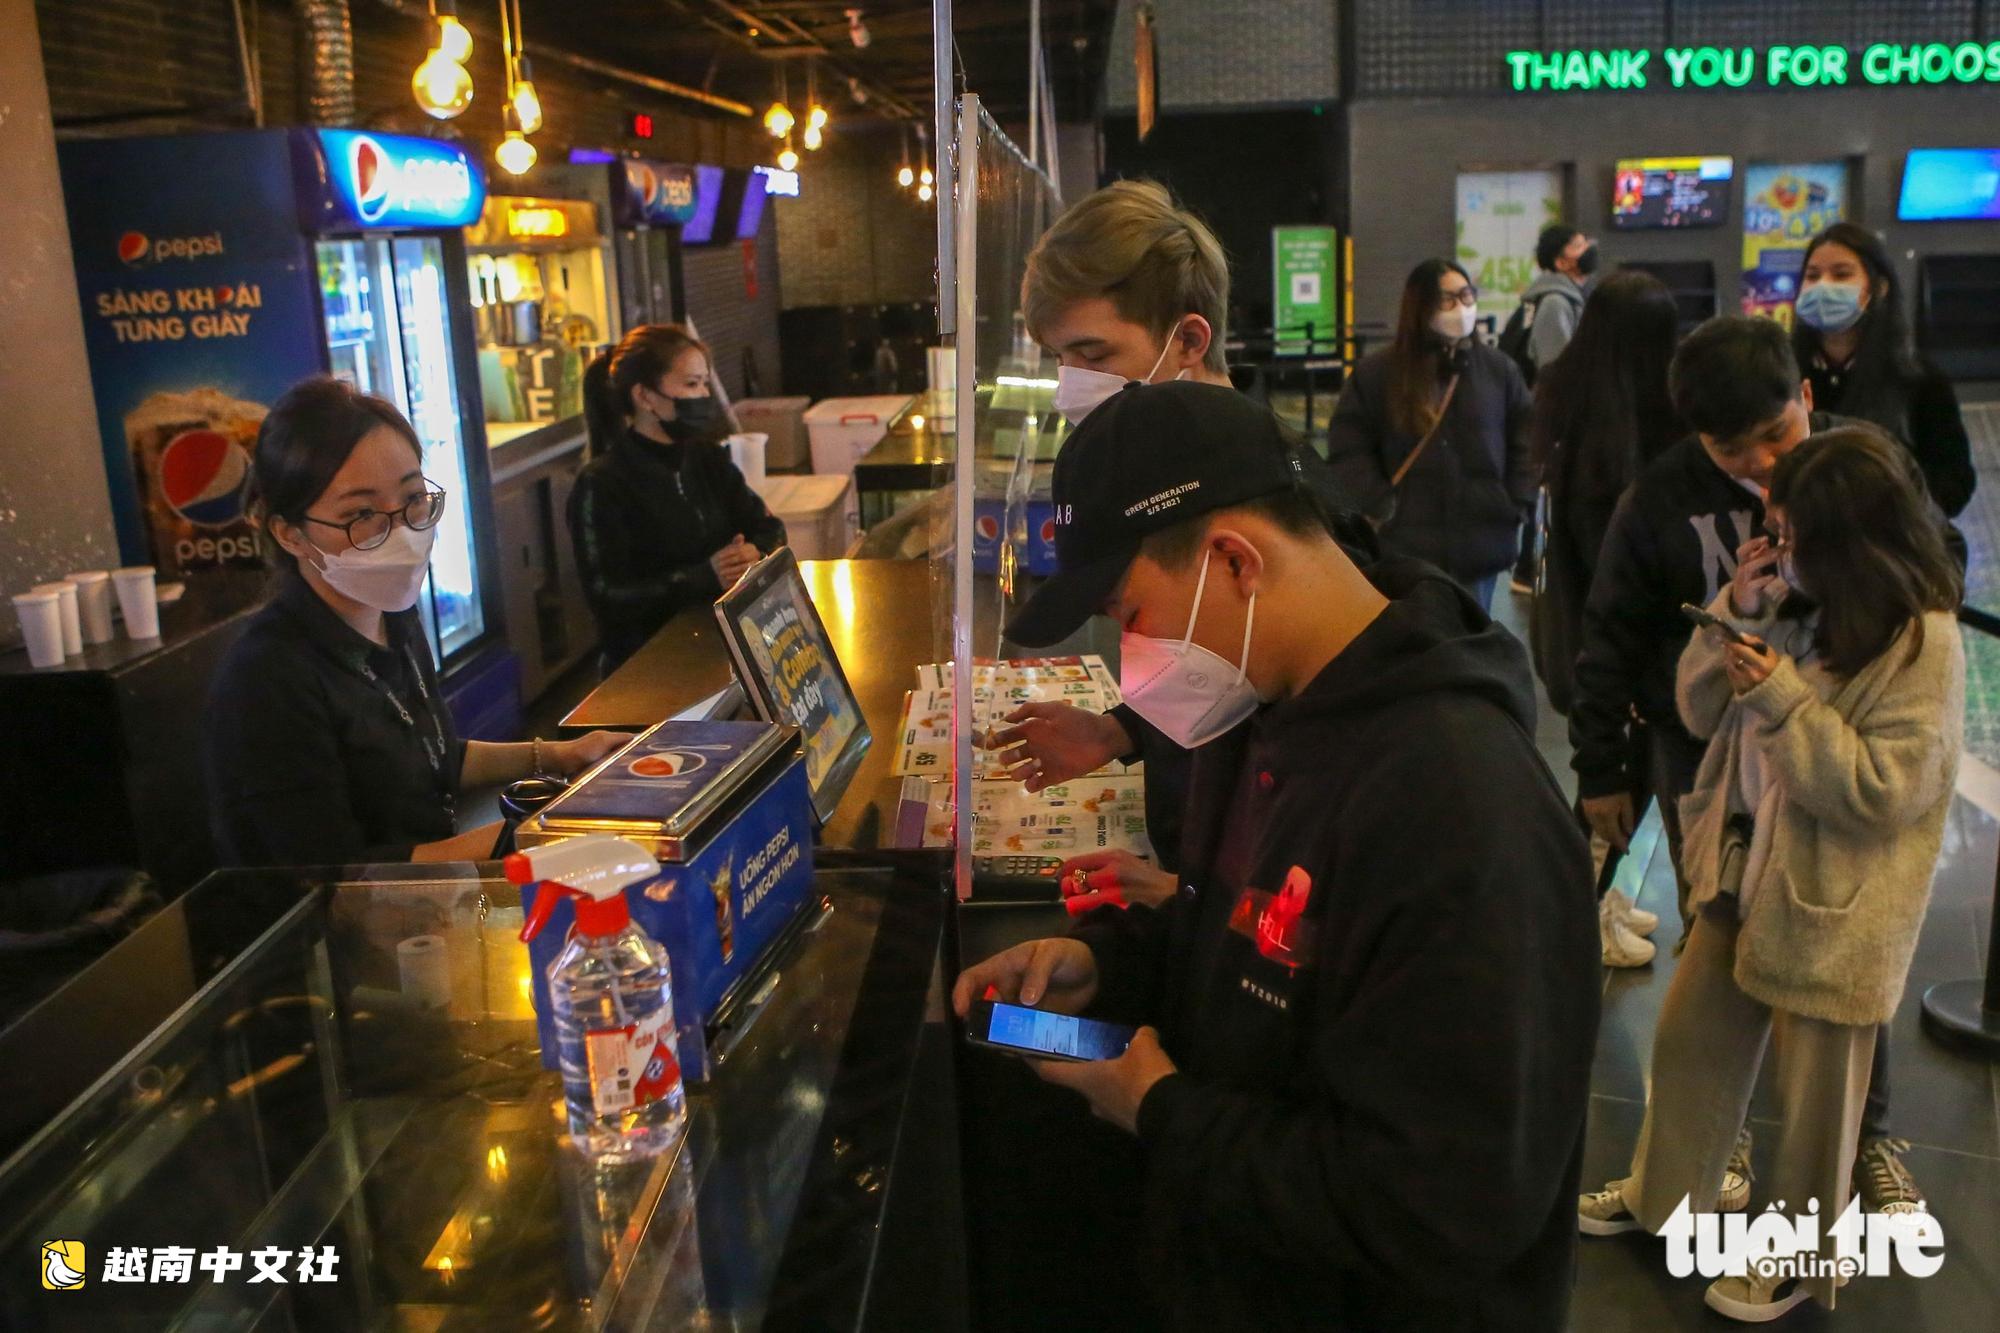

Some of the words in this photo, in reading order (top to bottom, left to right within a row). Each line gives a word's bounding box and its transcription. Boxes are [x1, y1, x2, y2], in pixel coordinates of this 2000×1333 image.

[1507, 49, 1649, 91] THANK
[1664, 47, 1754, 88] YOU
[1767, 44, 1847, 86] FOR
[154, 232, 224, 262] pepsi
[1124, 498, 1149, 517] GREEN
[1149, 480, 1200, 505] GENERATION
[1146, 504, 1161, 516] S/S
[1161, 497, 1181, 511] 2021
[175, 528, 261, 566] pepsi
[766, 825, 790, 862] PEPSI
[755, 862, 780, 902] NGON
